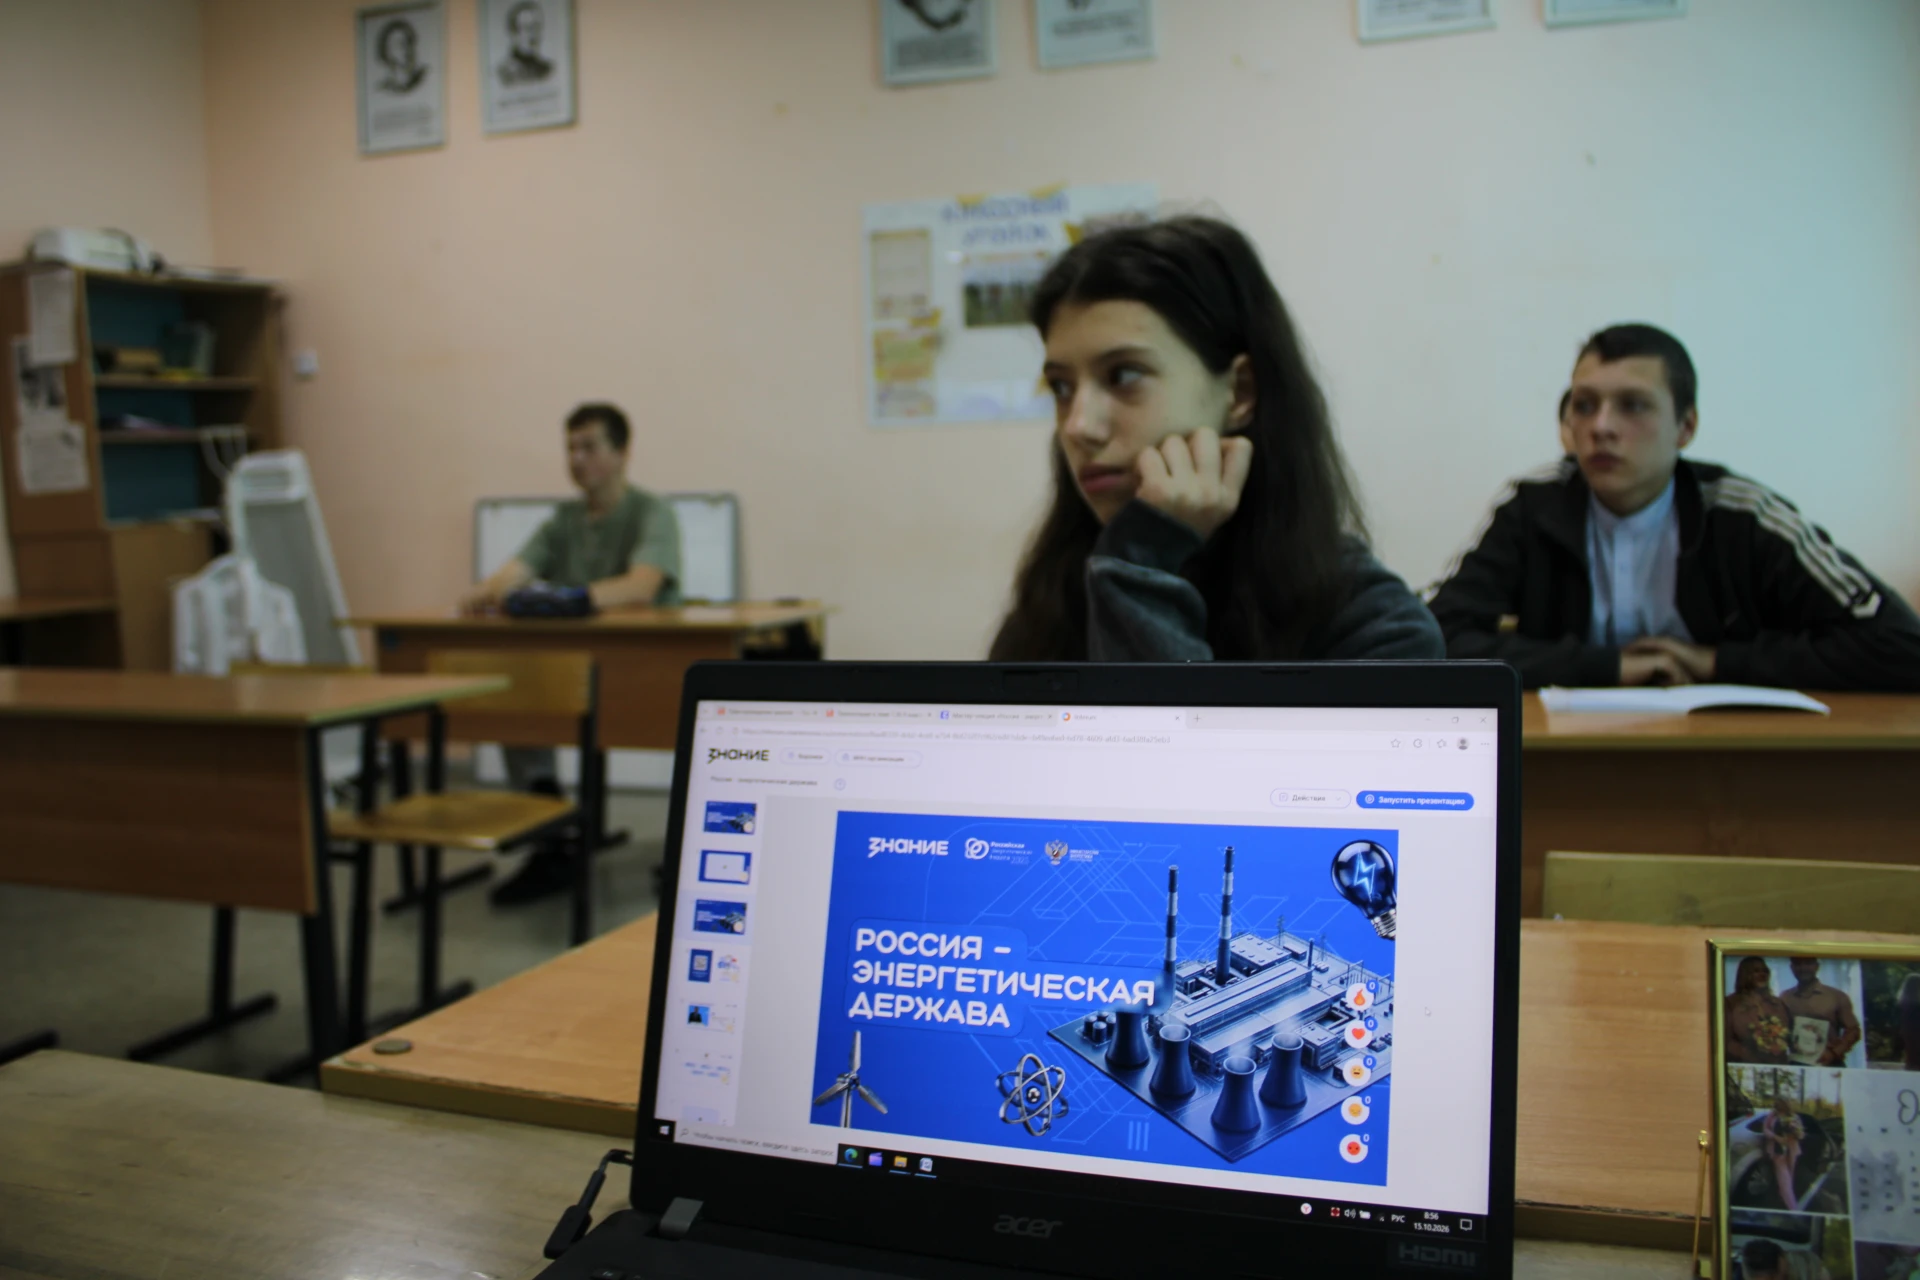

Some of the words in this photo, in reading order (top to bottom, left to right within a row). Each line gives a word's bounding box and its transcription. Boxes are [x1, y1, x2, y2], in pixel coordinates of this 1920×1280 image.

[1292, 794, 1326, 803] Действия
[1378, 796, 1415, 805] Запустить
[1416, 798, 1465, 806] презентацию
[867, 837, 949, 858] ЗНАНИЕ
[855, 928, 983, 961] РОССИЯ
[852, 959, 1155, 1006] ЭНЕРГЕТИЧЕСКАЯ
[848, 992, 1010, 1028] ДЕРЖАВА
[993, 1214, 1063, 1238] acer
[1391, 1214, 1405, 1223] РУС
[1424, 1211, 1439, 1220] 8:56
[1398, 1242, 1476, 1266] HDMI
